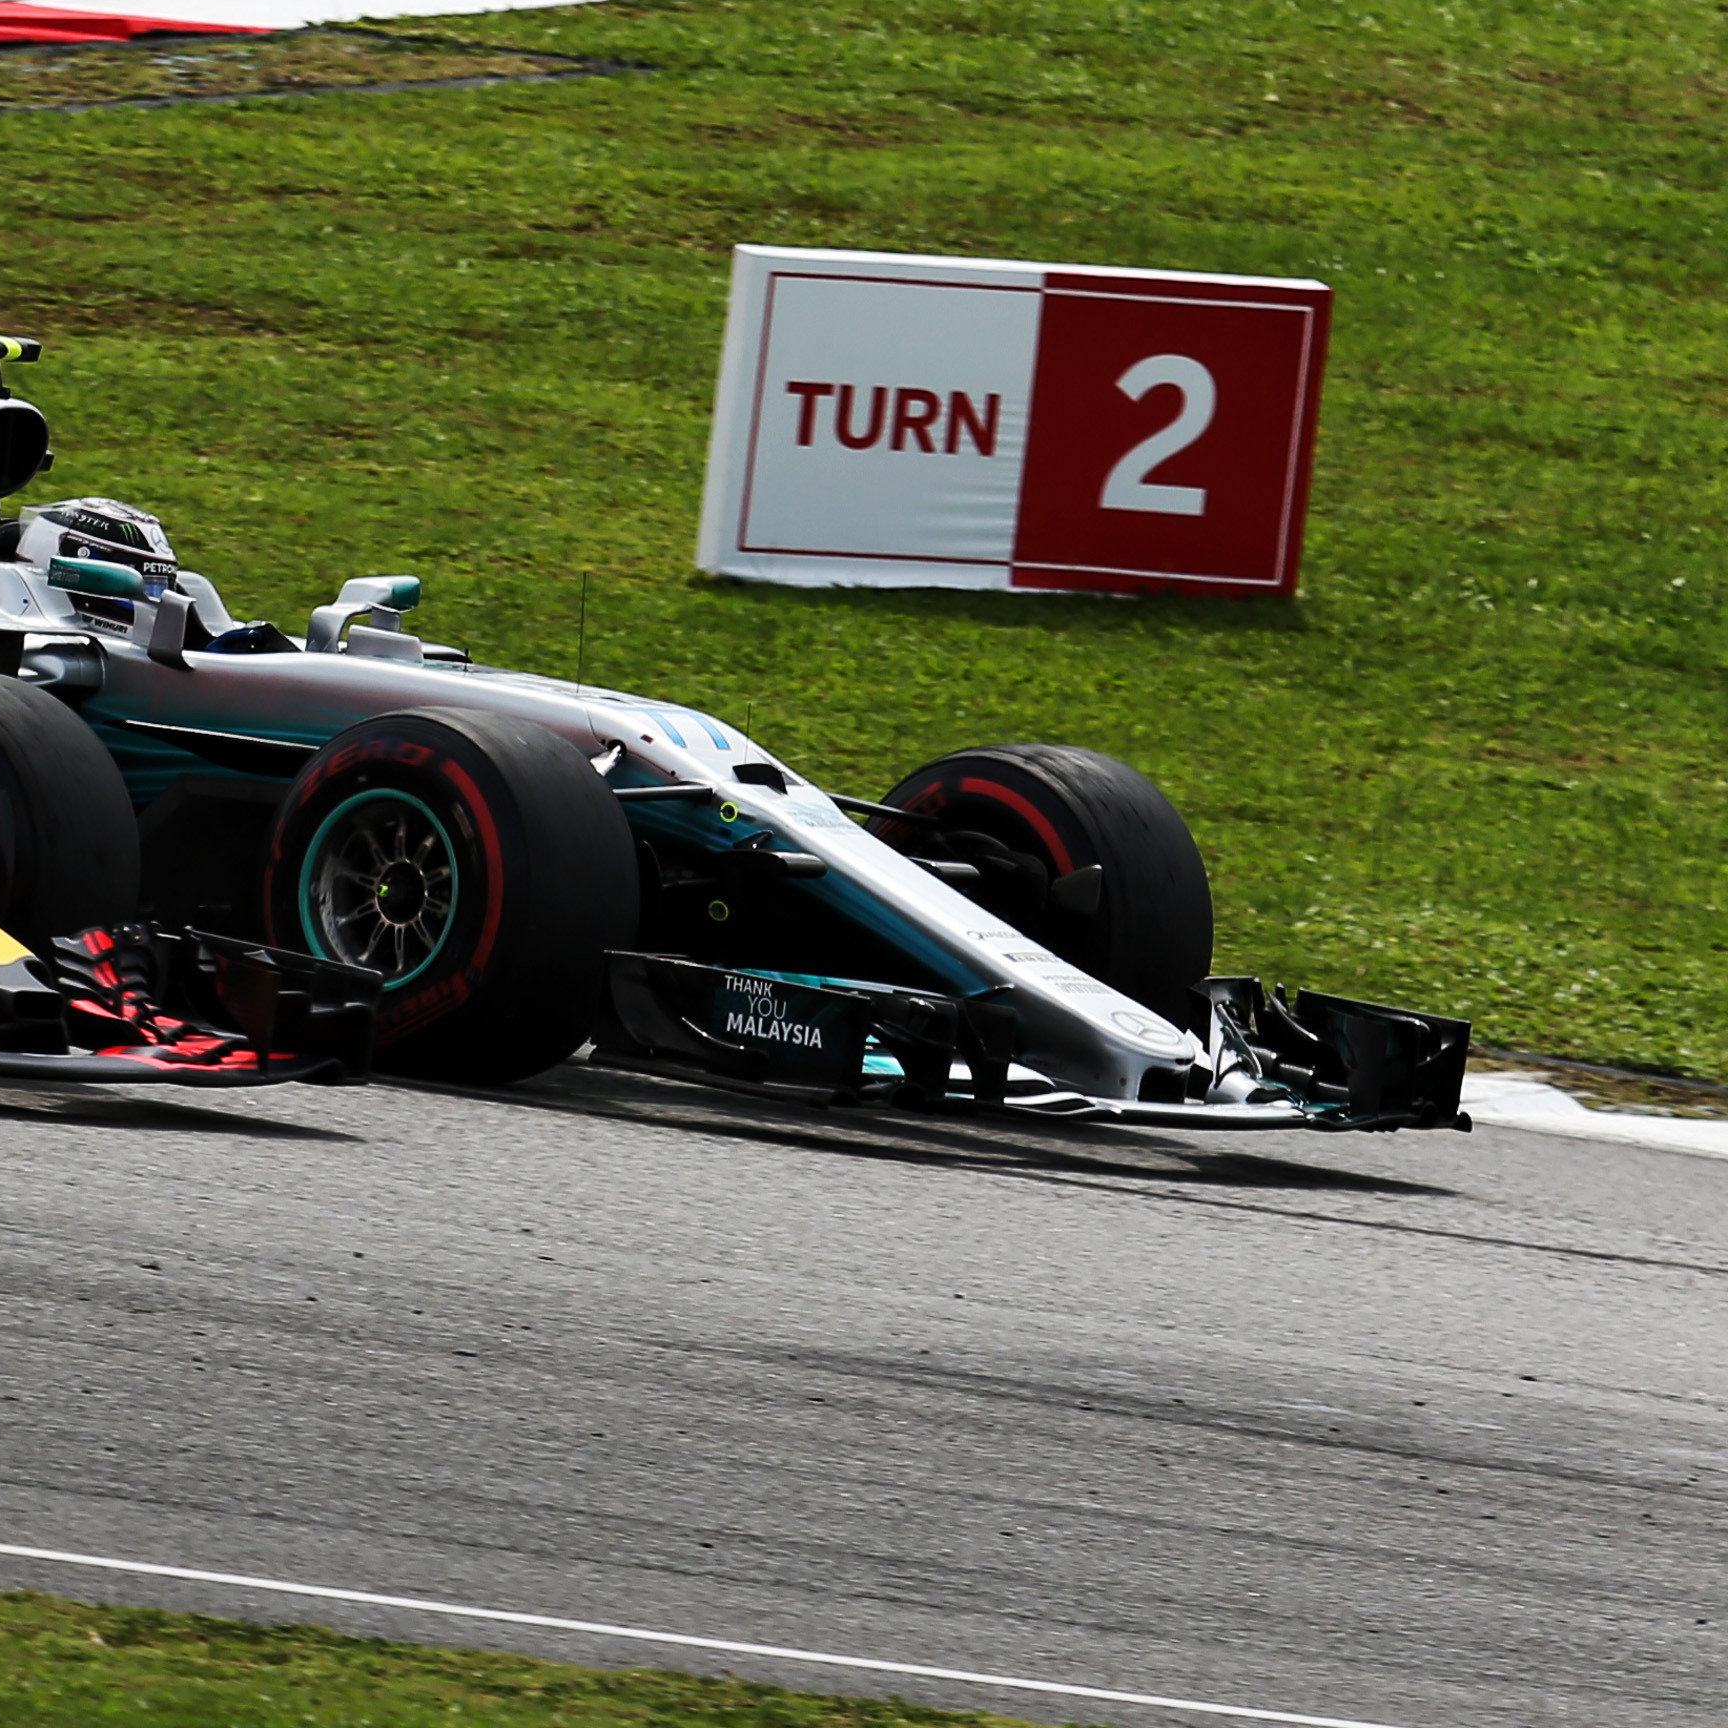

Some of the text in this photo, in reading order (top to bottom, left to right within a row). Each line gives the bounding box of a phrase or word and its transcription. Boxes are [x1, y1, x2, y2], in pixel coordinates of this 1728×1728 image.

[786, 353, 1218, 517] TURN 2
[724, 974, 773, 998] THANK
[747, 994, 787, 1020] YOU
[726, 1012, 823, 1049] MALAYSIA
